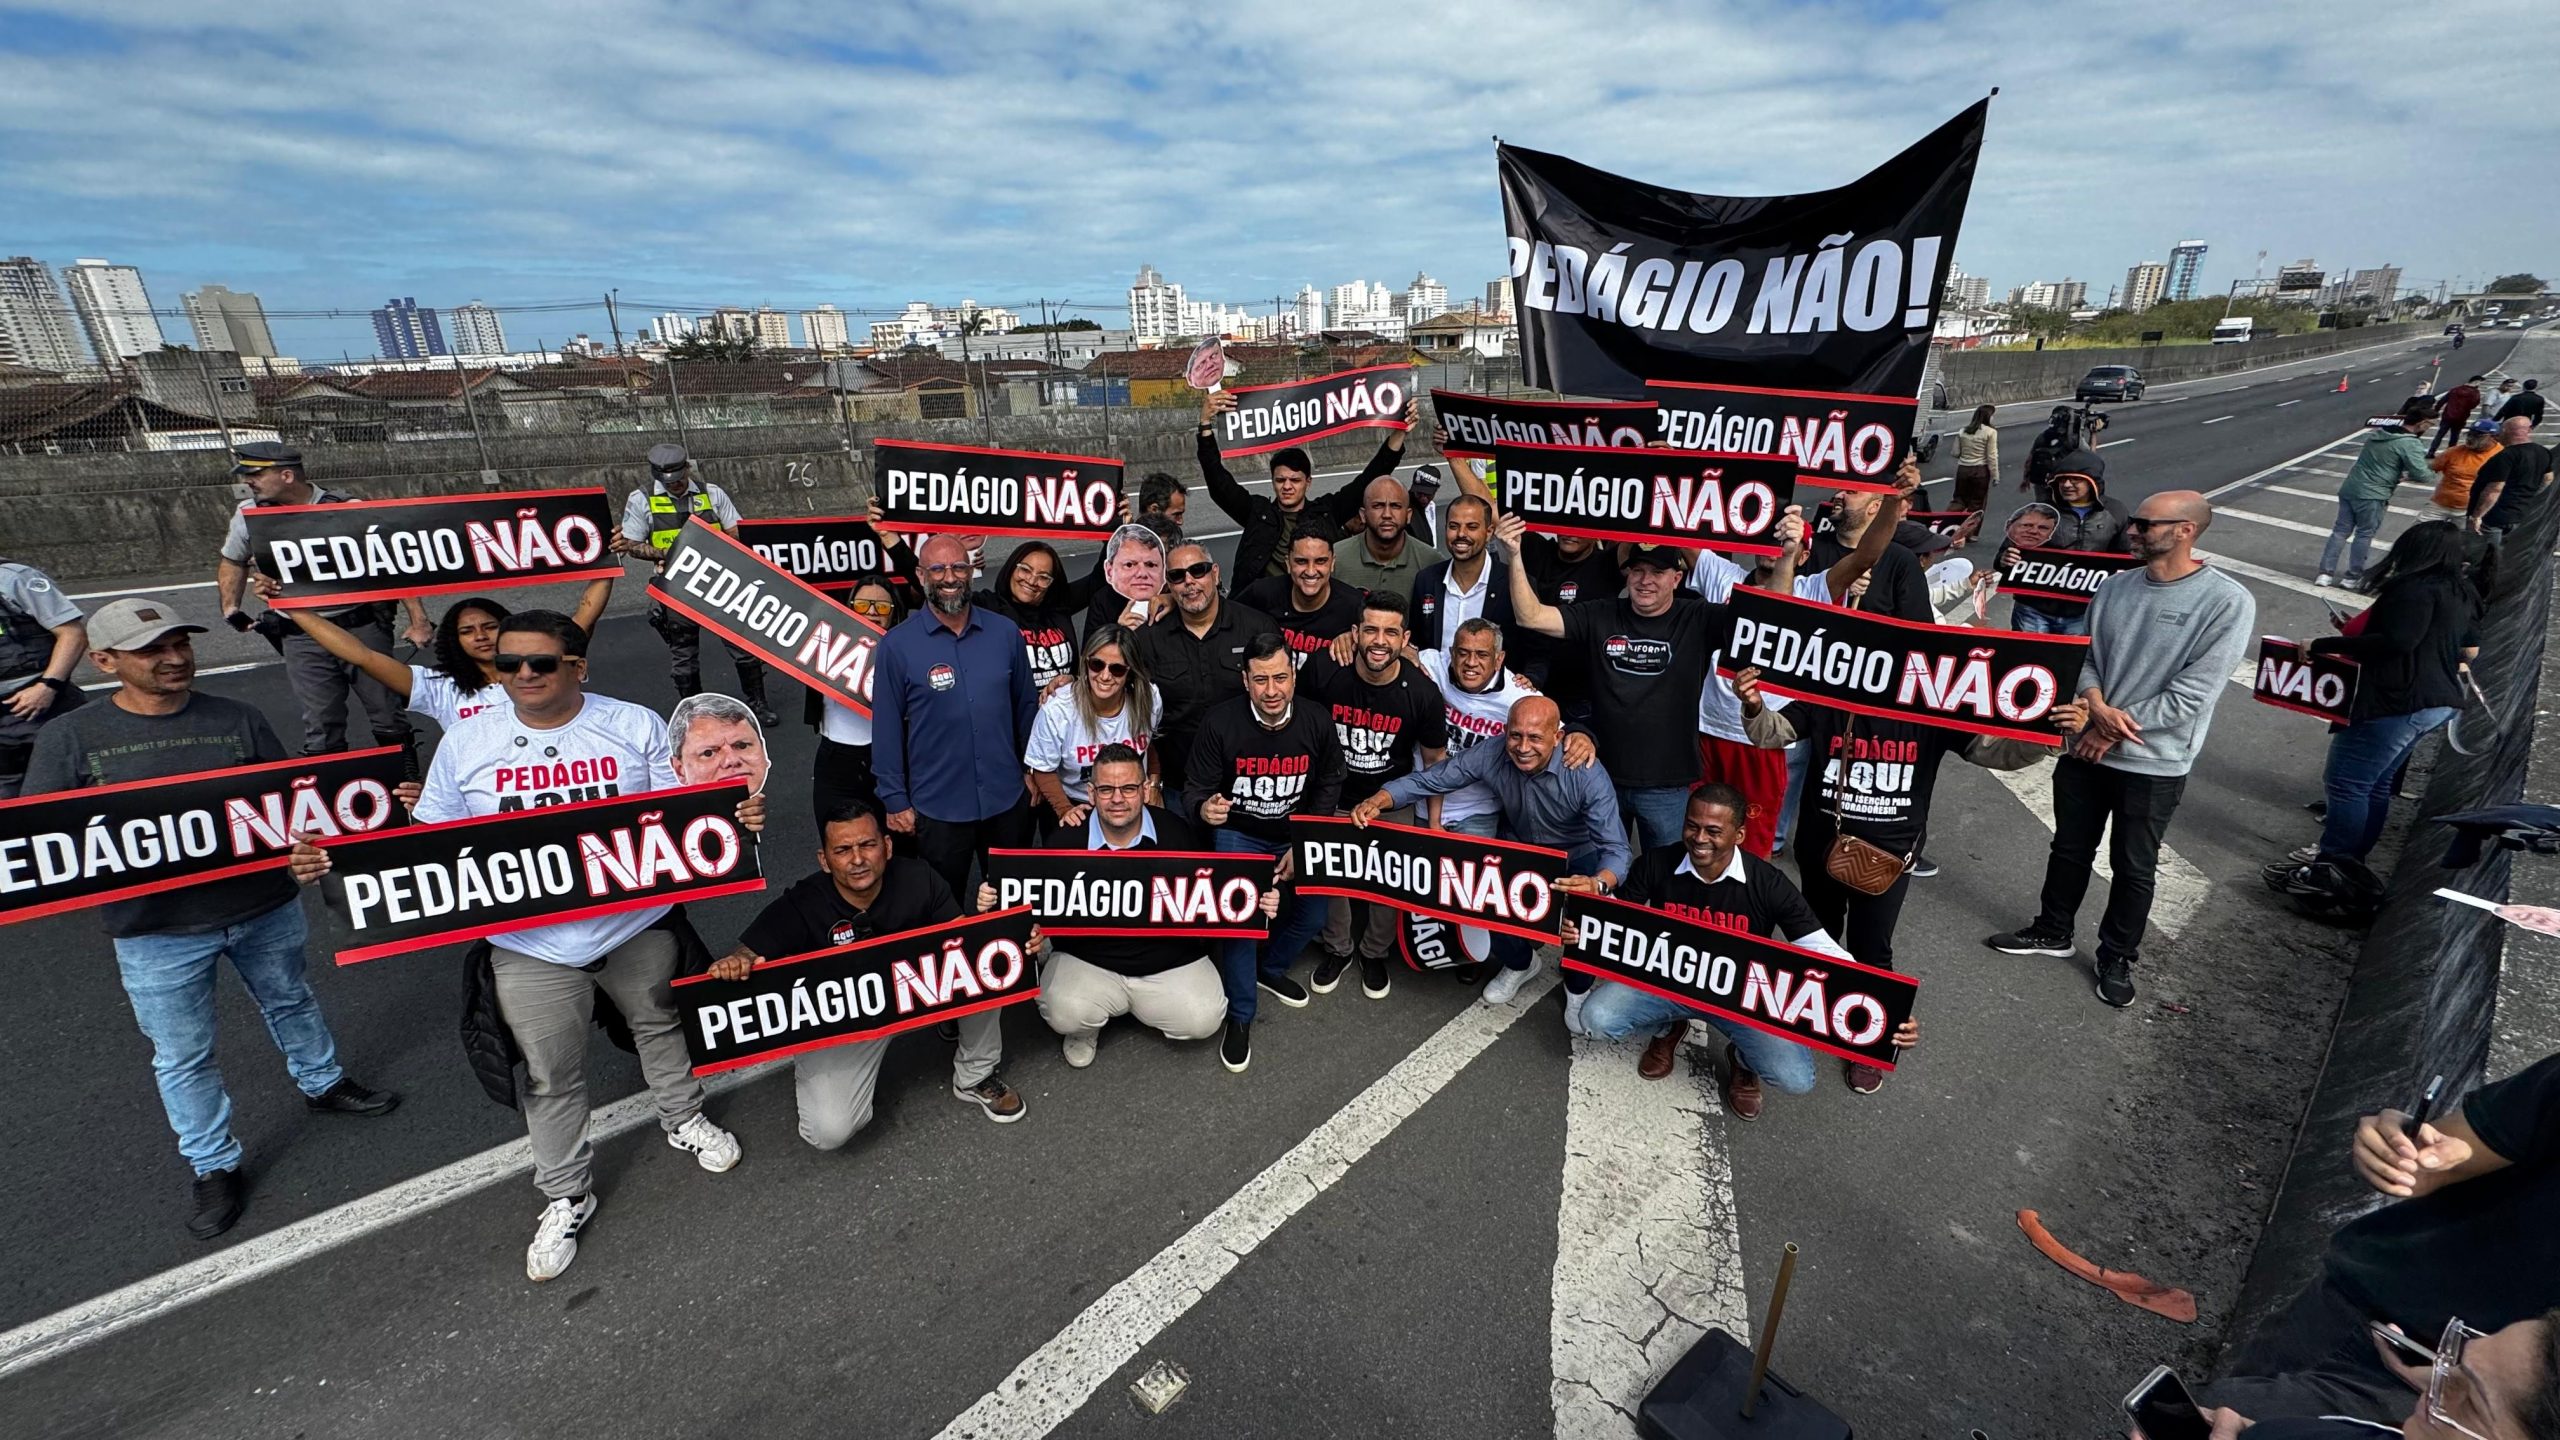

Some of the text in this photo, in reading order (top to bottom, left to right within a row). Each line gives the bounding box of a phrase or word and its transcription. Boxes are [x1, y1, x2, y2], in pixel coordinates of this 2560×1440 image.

[1507, 230, 1941, 334] PEDÁGIO NÃO!
[1225, 377, 1403, 441] PEDÁGIO NÃO
[1779, 410, 1895, 476] NÃO
[888, 467, 1116, 526] PEDÁGIO NÃO
[1506, 467, 1776, 537] PEDÁGIO NÃO
[270, 507, 602, 584] PEDÁGIO NÃO
[2008, 560, 2108, 592] PEDÁGIO
[664, 545, 809, 648] PEDÁGIO
[796, 621, 876, 703] NÃ
[1730, 616, 2057, 722] PEDÁGIO NÃO
[1332, 704, 1403, 733] PEDÁGIO
[496, 756, 618, 793] PEDÁGIO
[1232, 774, 1307, 801] AQUI
[1236, 754, 1309, 775] PEDÁGIO
[1823, 759, 1915, 794] AQUI
[0, 775, 391, 894] EDÁGIO NÃO
[343, 811, 741, 931] PEDÁGIO NÃO
[1001, 867, 1259, 924] PEDÁGIO NÃO
[1303, 840, 1551, 923] PEDÁGIO NÃO
[697, 937, 1024, 1050] PEDÁGIO NÃO
[1577, 914, 1888, 1046] PEDÁGIO NÃO
